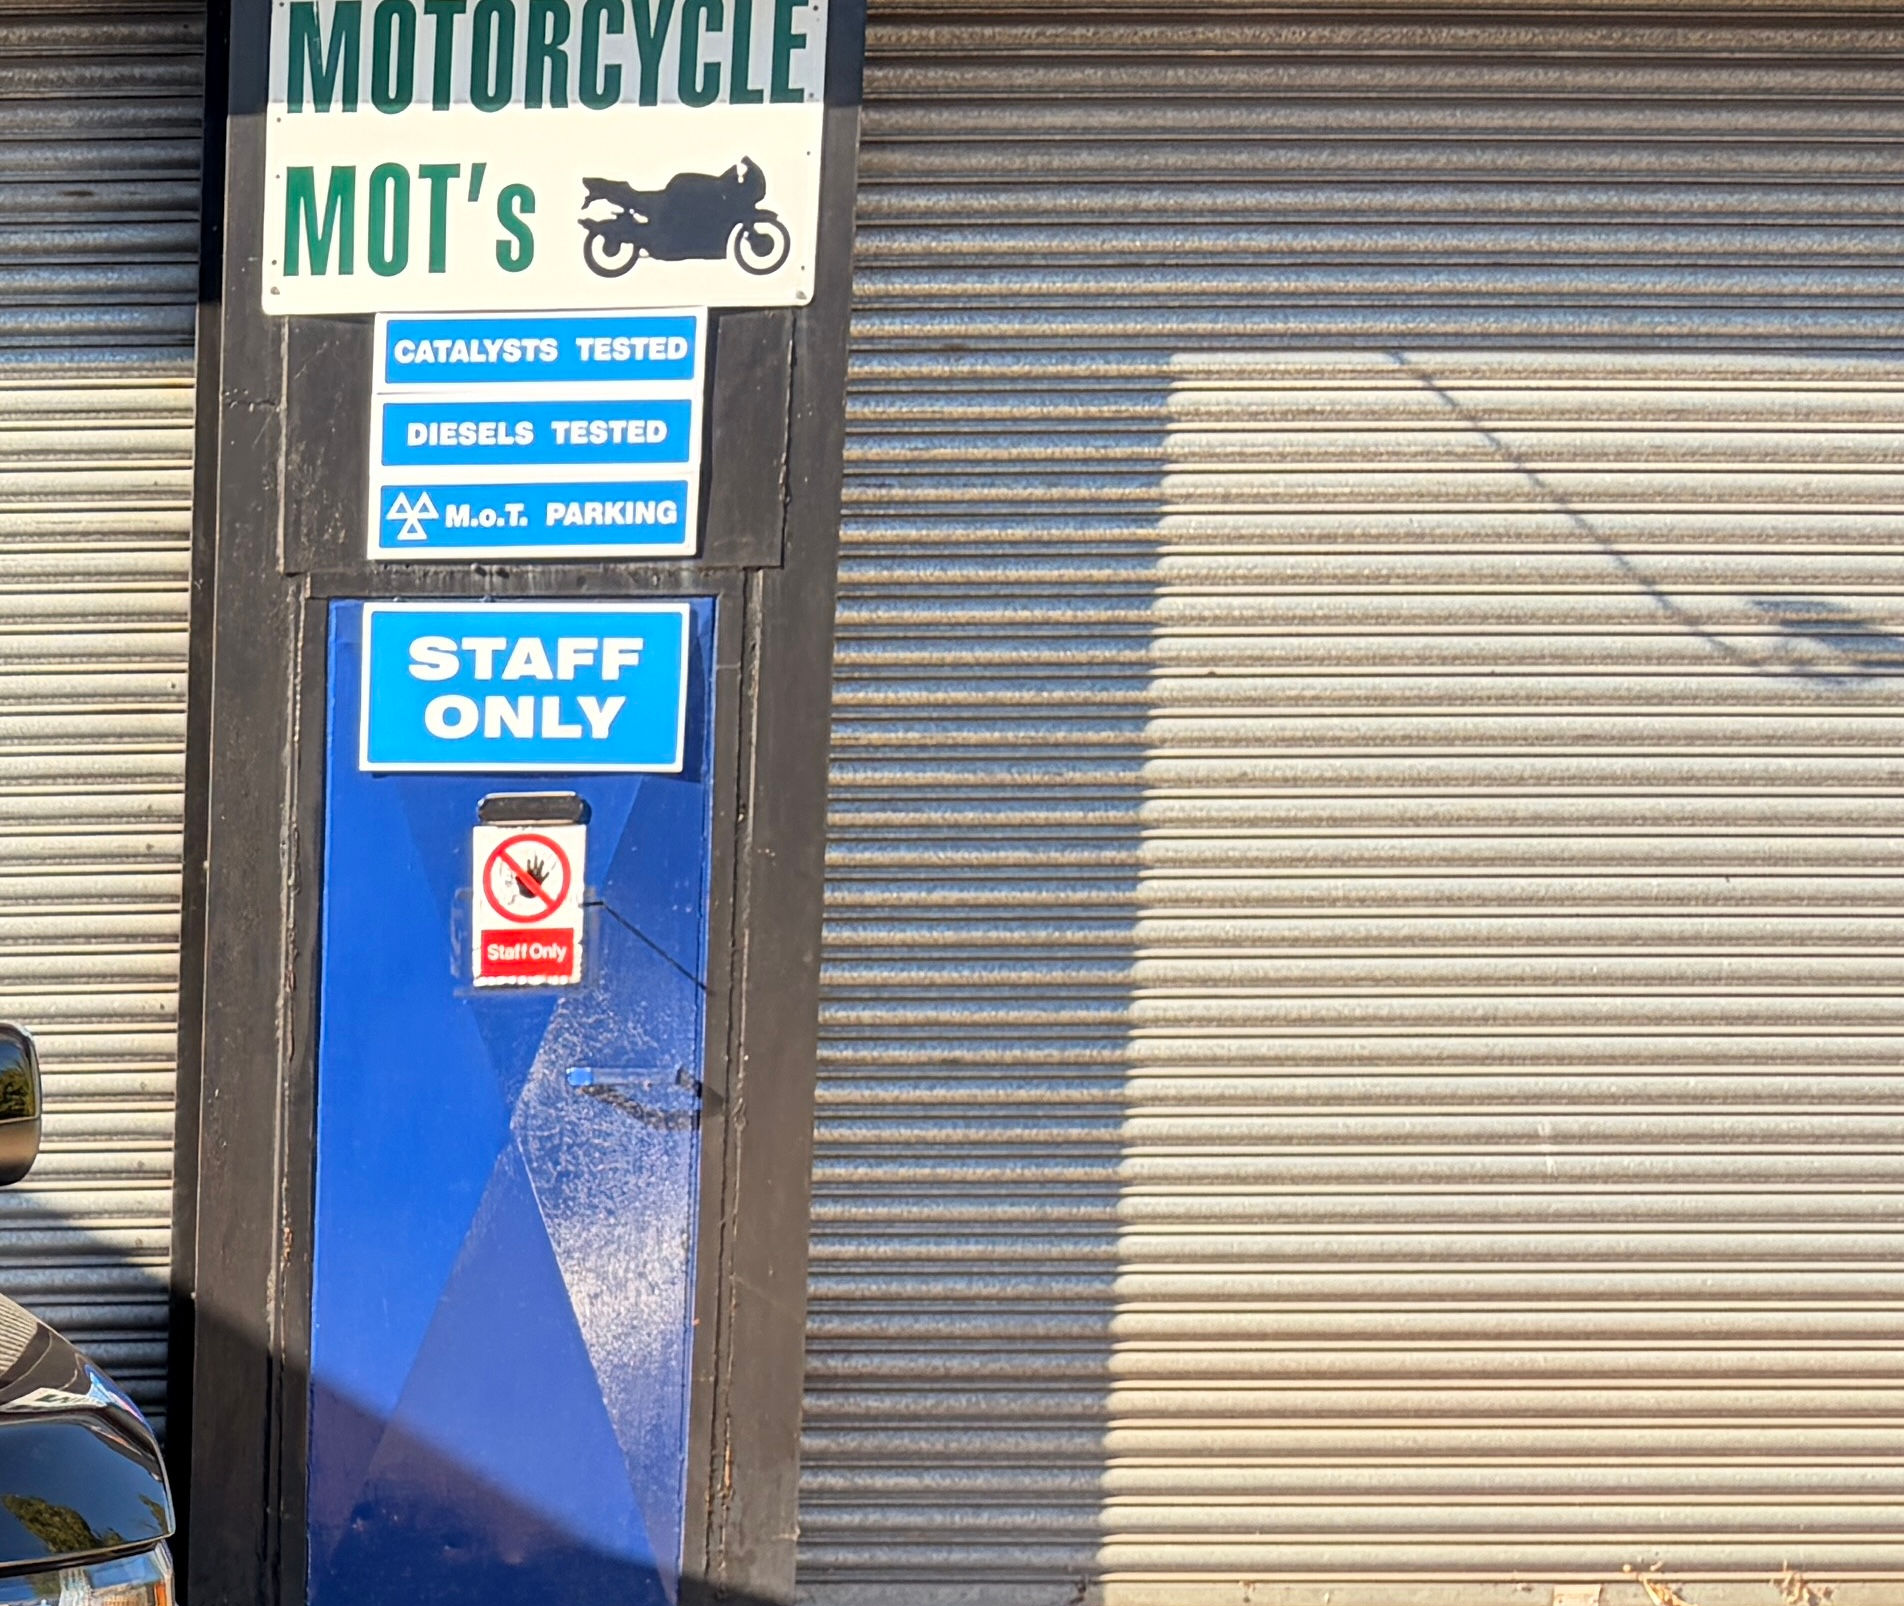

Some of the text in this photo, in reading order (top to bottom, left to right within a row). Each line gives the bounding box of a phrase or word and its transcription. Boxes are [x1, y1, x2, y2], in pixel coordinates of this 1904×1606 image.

[286, 0, 810, 114] MOTORCYCLE
[283, 162, 536, 277] MOT's
[393, 336, 689, 364] CATALYSTS TESTED
[406, 419, 668, 447] DIESELS TESTED
[445, 500, 678, 528] M.o.T. PARKING
[408, 635, 644, 681] STAFF
[424, 694, 627, 740] ONLY
[486, 942, 568, 962] Staff Only
